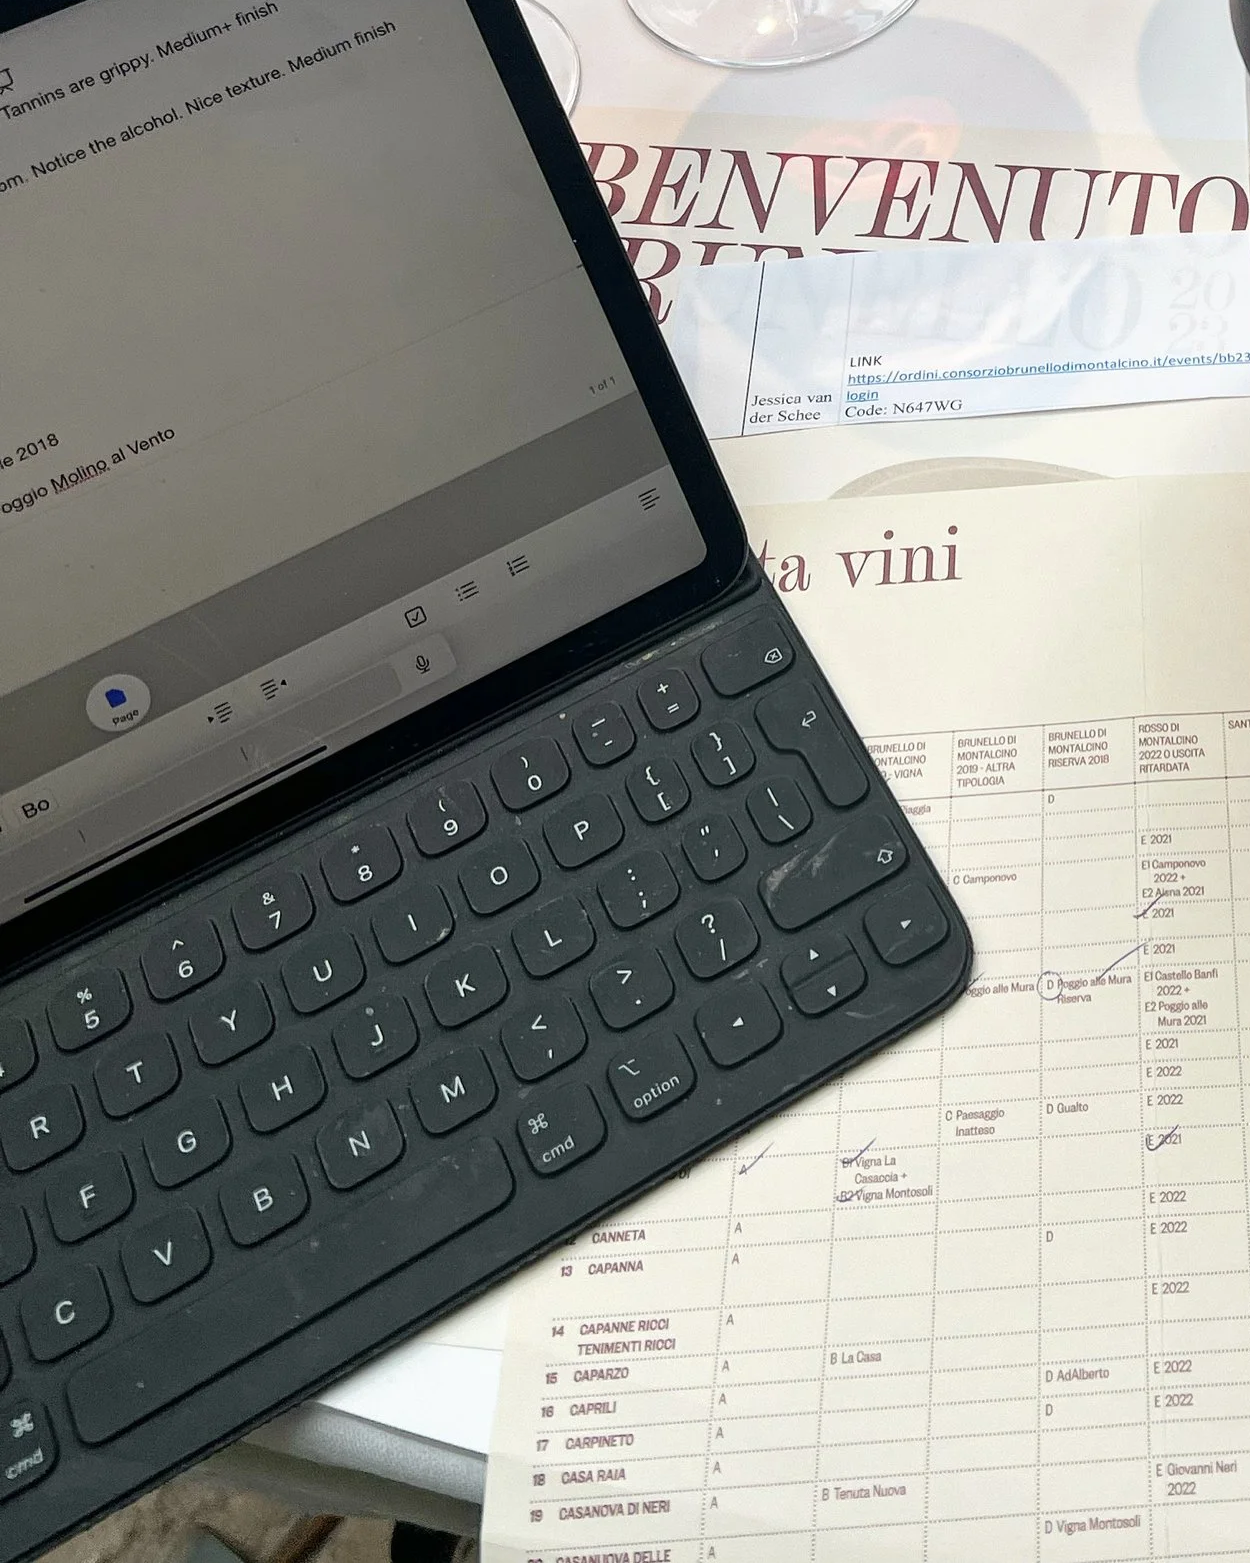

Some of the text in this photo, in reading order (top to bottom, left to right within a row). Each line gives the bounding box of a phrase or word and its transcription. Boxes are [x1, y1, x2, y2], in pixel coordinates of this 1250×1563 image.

[1, 0, 280, 121] Tannins are grippy. Medium+ finish
[30, 146, 87, 179] Notice
[89, 134, 117, 156] the
[119, 107, 184, 143] alcohol.
[184, 88, 224, 116] Nice
[226, 69, 286, 99] texture.
[287, 36, 352, 74] Medium
[353, 18, 397, 46] finish
[849, 355, 882, 368] LINK
[750, 393, 832, 408] Jessica van
[846, 389, 879, 403] login
[749, 409, 821, 424] der Schee
[844, 399, 963, 418] Code: N647WG
[16, 433, 59, 461] 2018
[50, 460, 107, 491] Molino
[111, 448, 126, 464] al
[127, 429, 175, 455] Vento
[835, 523, 963, 589] vini
[1139, 761, 1190, 774] RITARDATA
[442, 818, 460, 835] 9
[574, 819, 590, 840] P
[358, 863, 374, 881] 8
[456, 976, 475, 995] K
[83, 1009, 100, 1028] 5
[126, 1062, 143, 1083] T
[632, 1072, 682, 1111] option
[541, 1134, 577, 1165] cmd
[254, 1189, 272, 1211] B
[591, 1228, 646, 1244] CANNETA
[588, 1260, 644, 1275] CAPANNA
[55, 1301, 75, 1325] C
[579, 1318, 670, 1336] CAPANNE RICCI
[578, 1338, 676, 1356] TENIMENTI RICCI
[573, 1366, 629, 1383] CAPARZO
[569, 1401, 617, 1417] CAPRILI
[565, 1433, 634, 1450] CARPINETO
[561, 1468, 627, 1484] CASA RAIA
[558, 1499, 671, 1521] CASANOVA DI NERI
